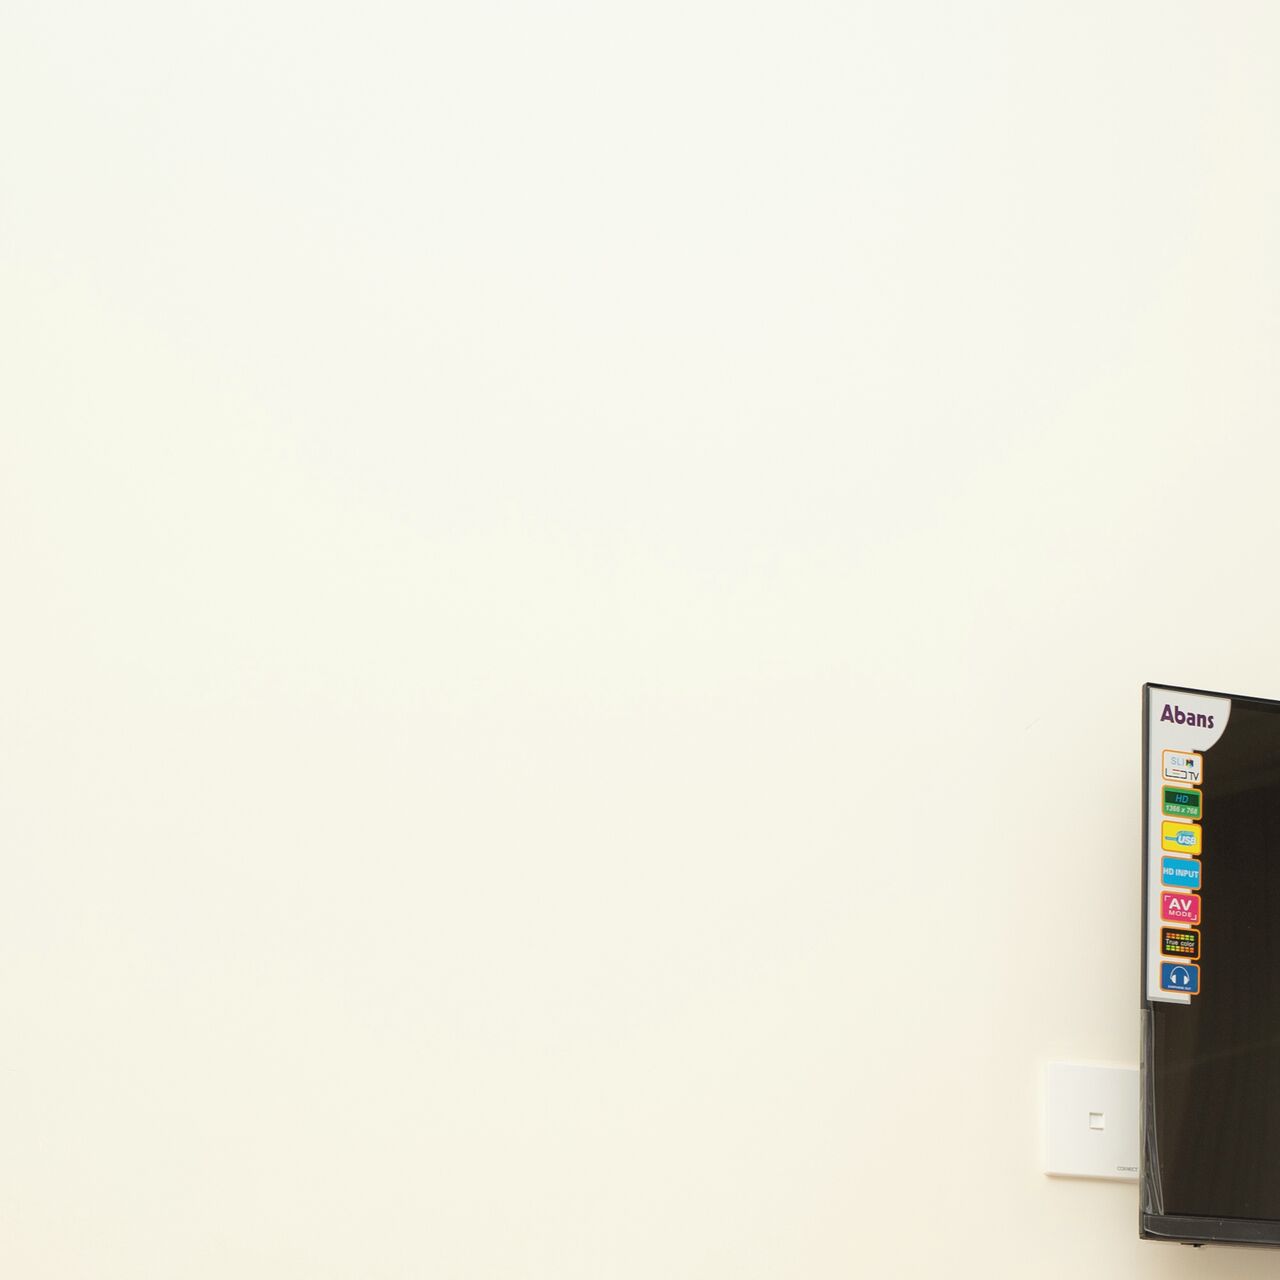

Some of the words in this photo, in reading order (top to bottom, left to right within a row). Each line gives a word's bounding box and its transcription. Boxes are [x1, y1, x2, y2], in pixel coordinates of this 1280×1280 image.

[1160, 704, 1214, 729] Abans
[1175, 793, 1189, 803] HD
[1178, 835, 1196, 846] USB
[1163, 867, 1174, 875] HD
[1175, 868, 1199, 878] INPUT
[1169, 898, 1192, 911] AV
[1168, 910, 1192, 918] MODE
[1165, 938, 1179, 946] True
